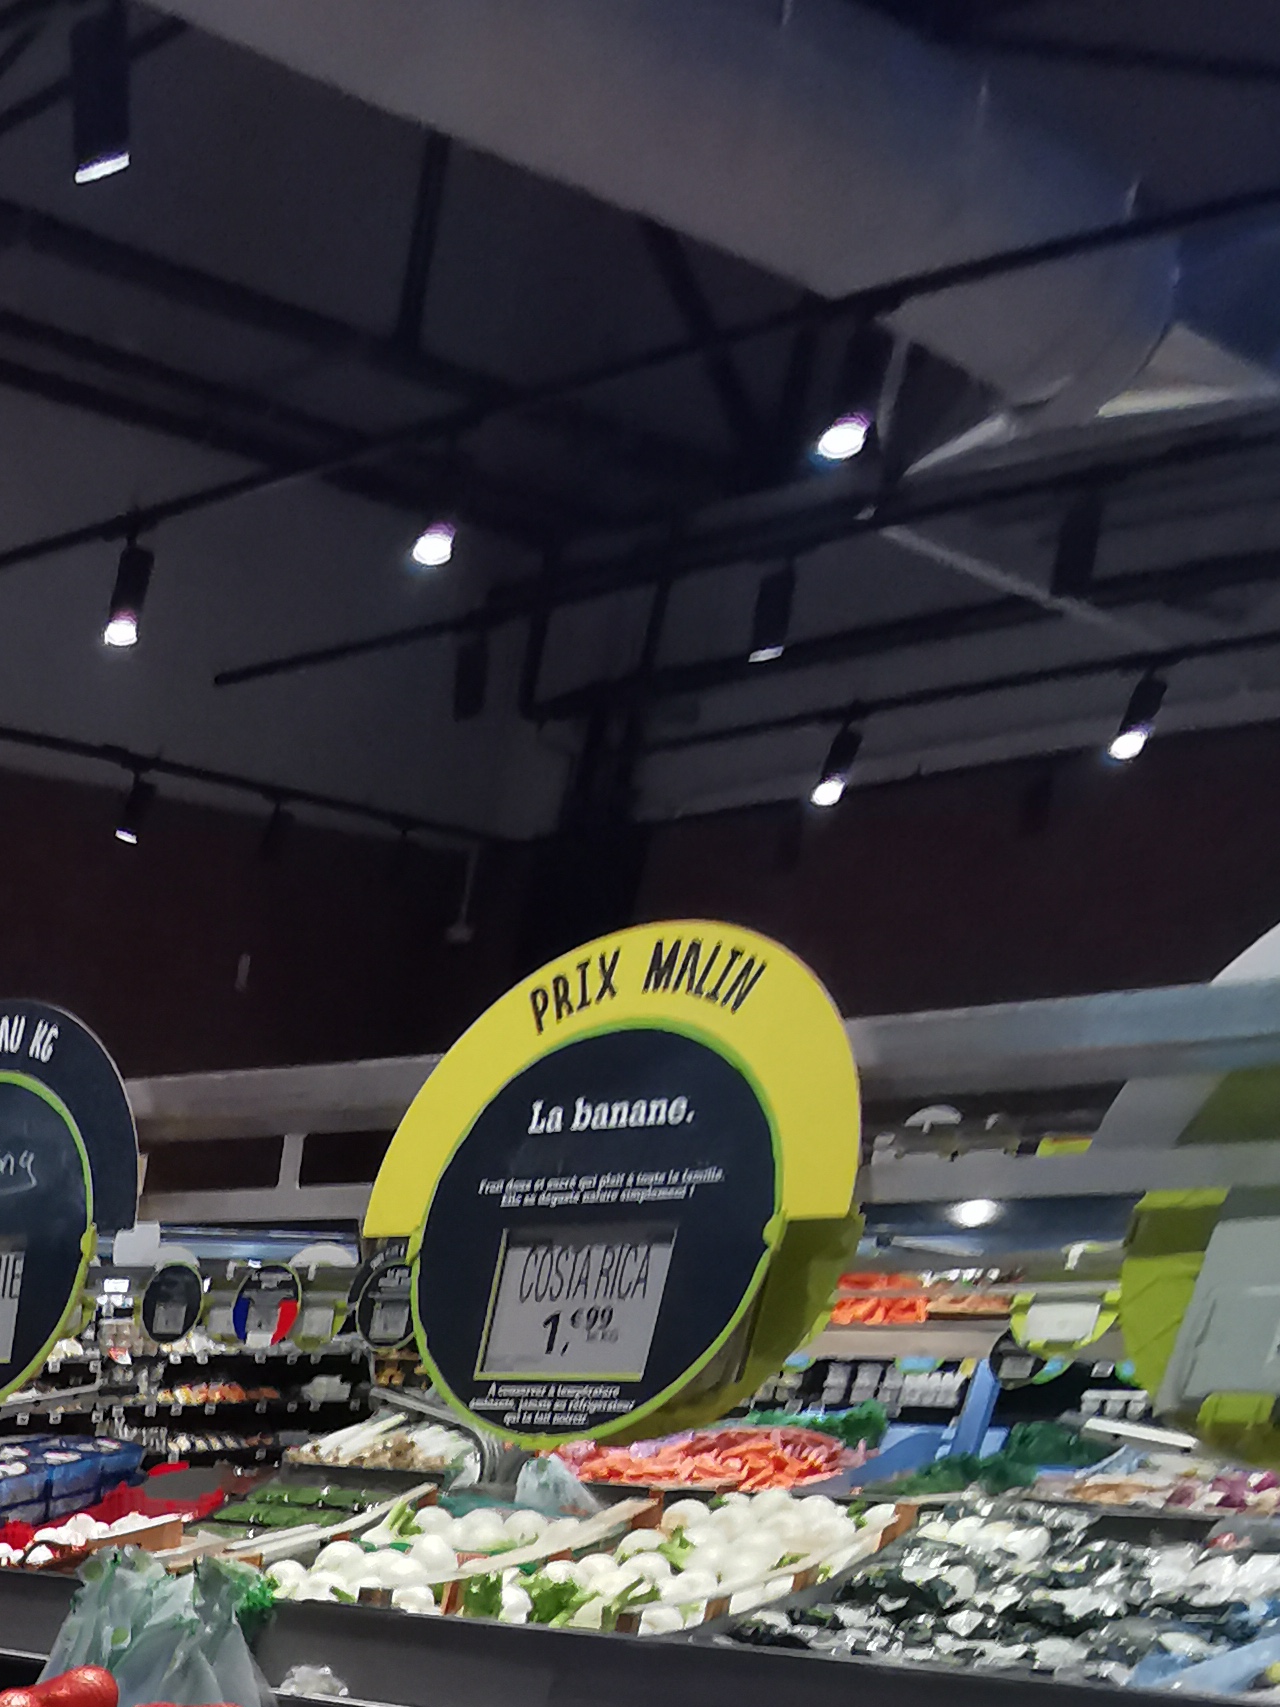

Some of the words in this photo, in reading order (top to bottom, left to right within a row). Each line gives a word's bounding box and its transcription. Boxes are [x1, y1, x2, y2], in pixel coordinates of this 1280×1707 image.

[530, 946, 622, 1035] PRIX
[642, 937, 767, 1014] MALIN
[29, 1019, 59, 1063] KG
[528, 1100, 564, 1134] La
[519, 1245, 591, 1303] COSTA
[594, 1244, 651, 1300] RICA
